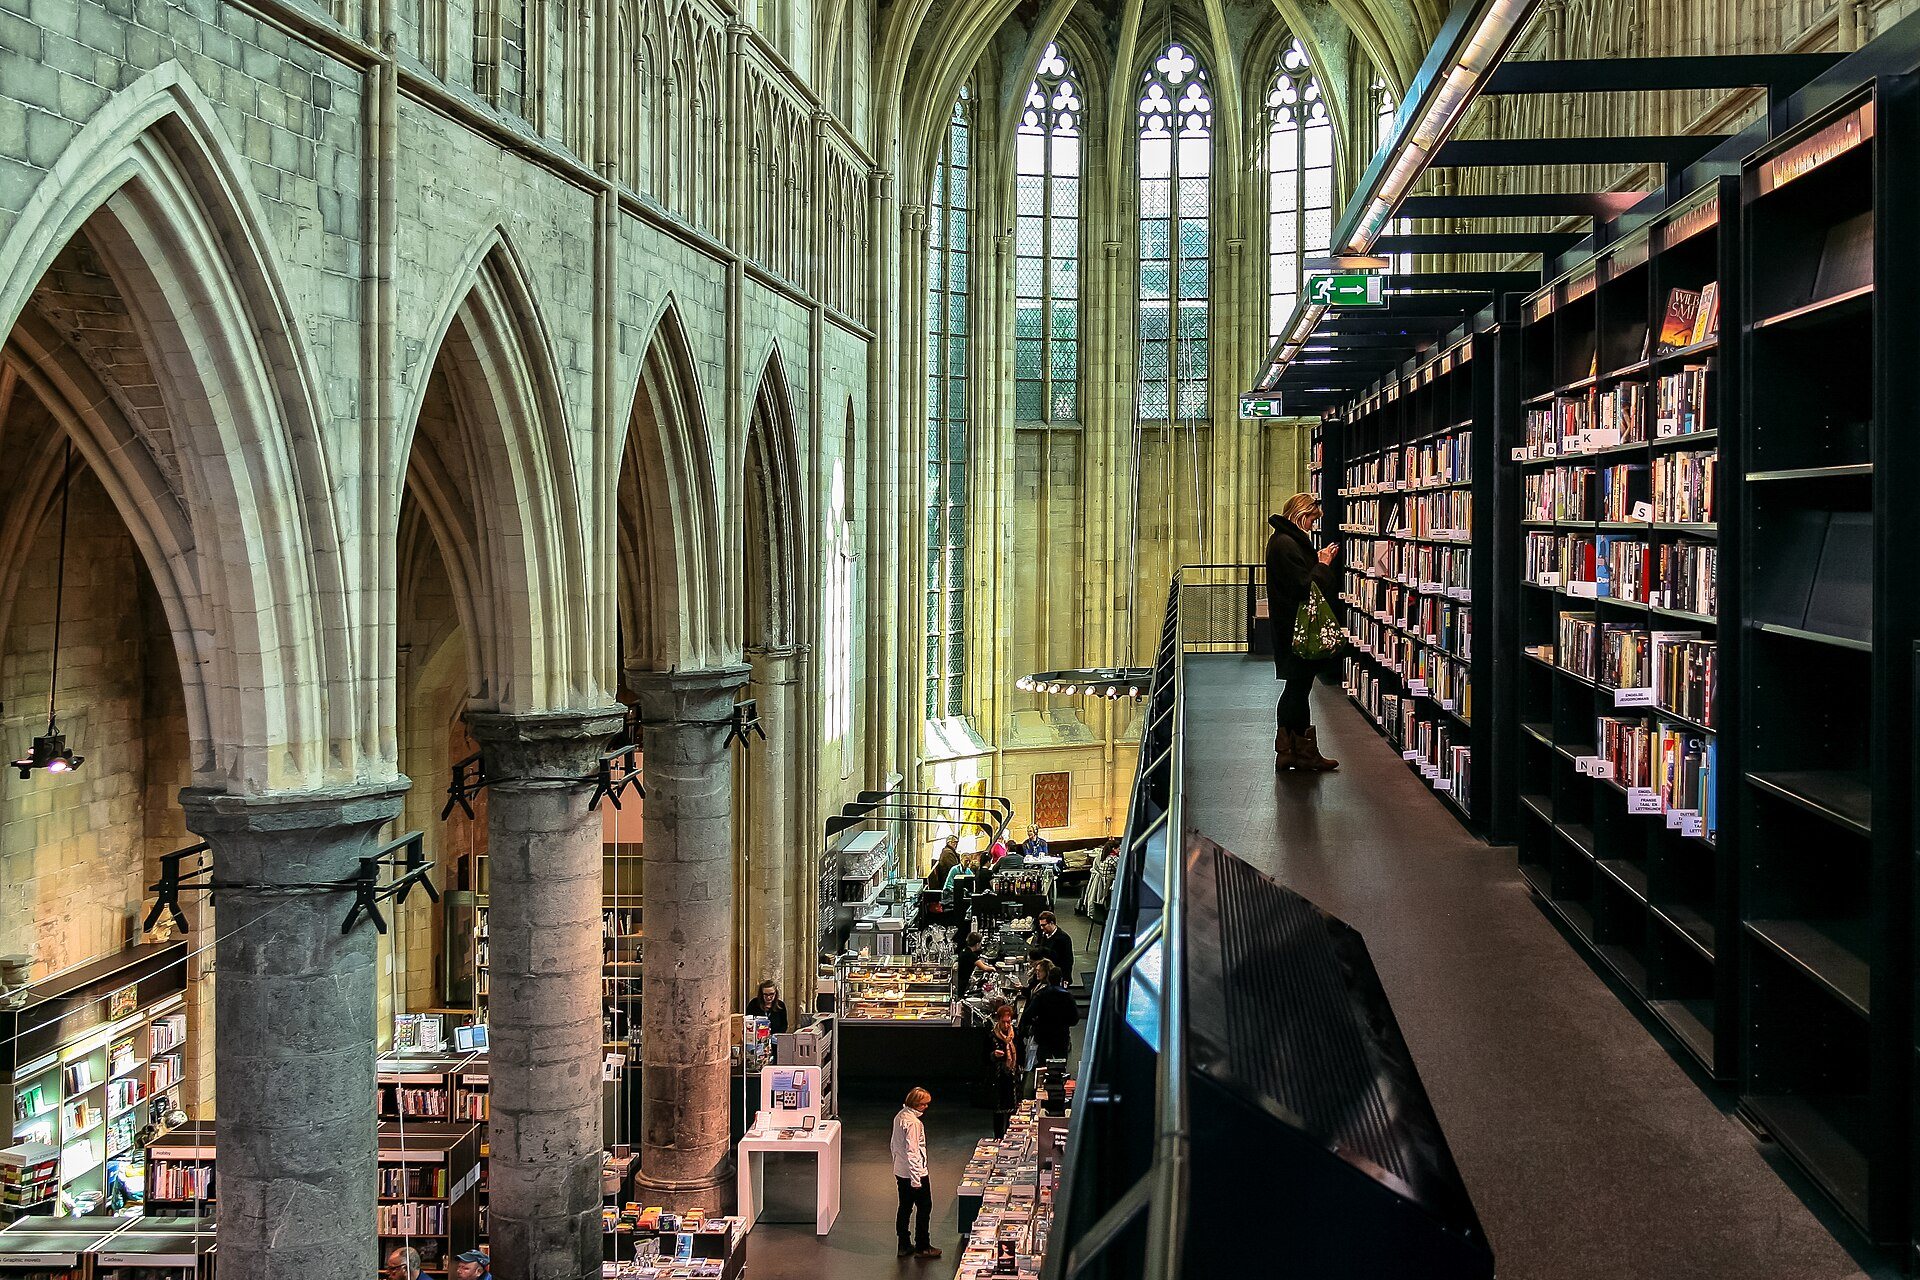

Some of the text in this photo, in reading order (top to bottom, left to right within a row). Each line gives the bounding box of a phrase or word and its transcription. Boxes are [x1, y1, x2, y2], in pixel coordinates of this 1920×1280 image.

[1663, 424, 1672, 434] R
[1583, 433, 1591, 443] K
[1515, 451, 1522, 459] A
[1548, 446, 1555, 455] D
[1637, 507, 1646, 518] S
[1543, 576, 1551, 584] H
[1571, 585, 1579, 595] L
[1580, 761, 1588, 770] N
[1597, 766, 1605, 775] P
